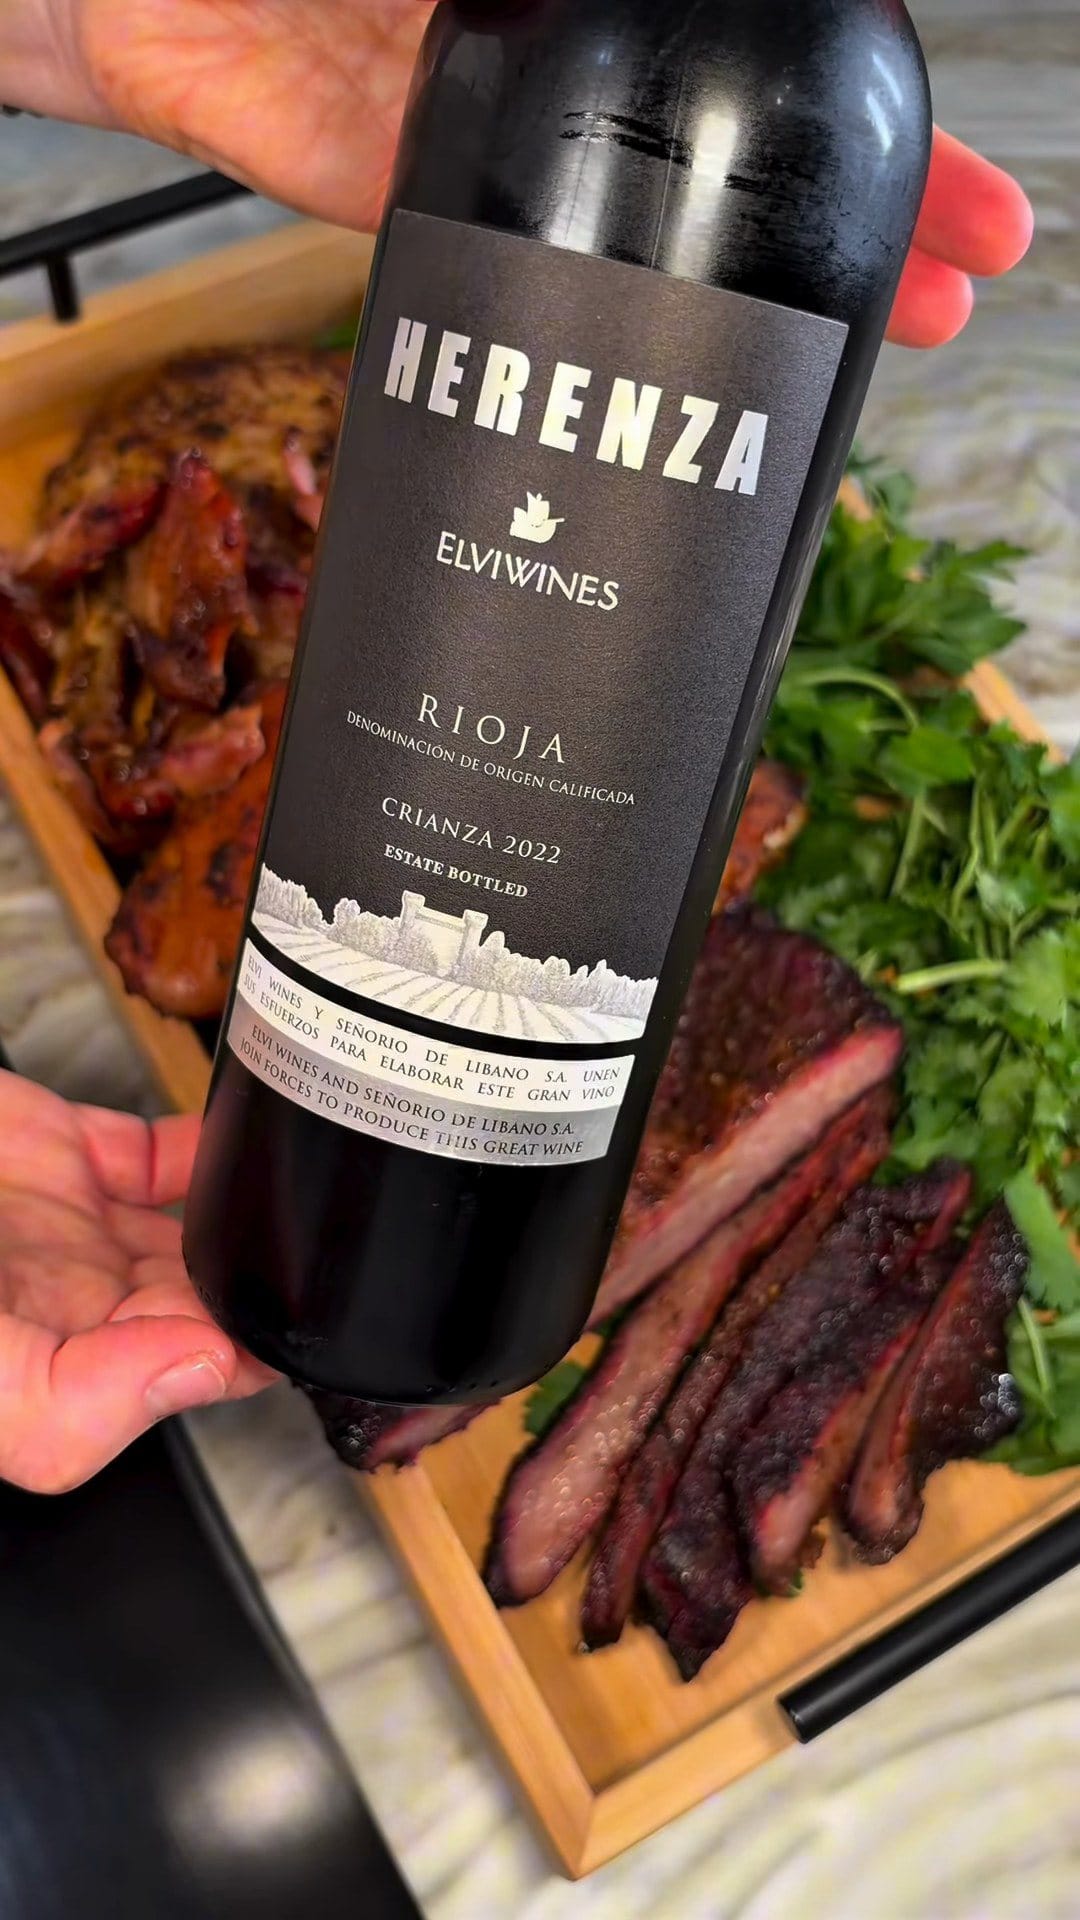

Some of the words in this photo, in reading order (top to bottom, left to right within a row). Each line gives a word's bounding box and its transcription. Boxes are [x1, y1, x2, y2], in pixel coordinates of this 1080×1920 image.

[384, 317, 768, 495] HERENZA
[436, 531, 619, 610] ELVIWINES
[347, 711, 455, 763] DENOMINACIÓN
[460, 755, 480, 771] DE
[484, 762, 544, 788] ORIGEN
[549, 779, 635, 805] CALIFICADA
[417, 693, 565, 763] RIOJA
[381, 797, 493, 849] CRIANZA
[502, 835, 561, 864] 2022
[384, 844, 443, 875] ESTATE
[448, 866, 528, 897] BOTTLED
[248, 955, 262, 979] ELVI
[269, 976, 302, 1009] WINES
[315, 1006, 323, 1019] Y
[336, 1018, 407, 1053] SEÑORIO
[425, 1050, 448, 1065] DE
[466, 1060, 529, 1080] LIBANO
[583, 1067, 620, 1082] UNEN
[260, 992, 319, 1039] ESFUERZOS
[330, 1036, 366, 1061] PARA
[380, 1056, 464, 1090] ELABORAR
[478, 1083, 515, 1098] ESTE
[528, 1089, 570, 1101] GRAN
[582, 1086, 615, 1100] VINO
[240, 1038, 262, 1065] JOIN
[264, 1059, 313, 1098] FORCES
[317, 1090, 338, 1109] TO
[344, 1102, 429, 1140] PRODUCE
[484, 1140, 538, 1155] GREAT
[543, 1141, 583, 1155] WINE
[252, 1025, 273, 1051] ELVI
[276, 1043, 319, 1077] WINES
[321, 1072, 359, 1095] AND
[363, 1088, 445, 1122] SEÑORIO
[452, 1114, 476, 1128] DE
[482, 1118, 547, 1135] LIBANO
